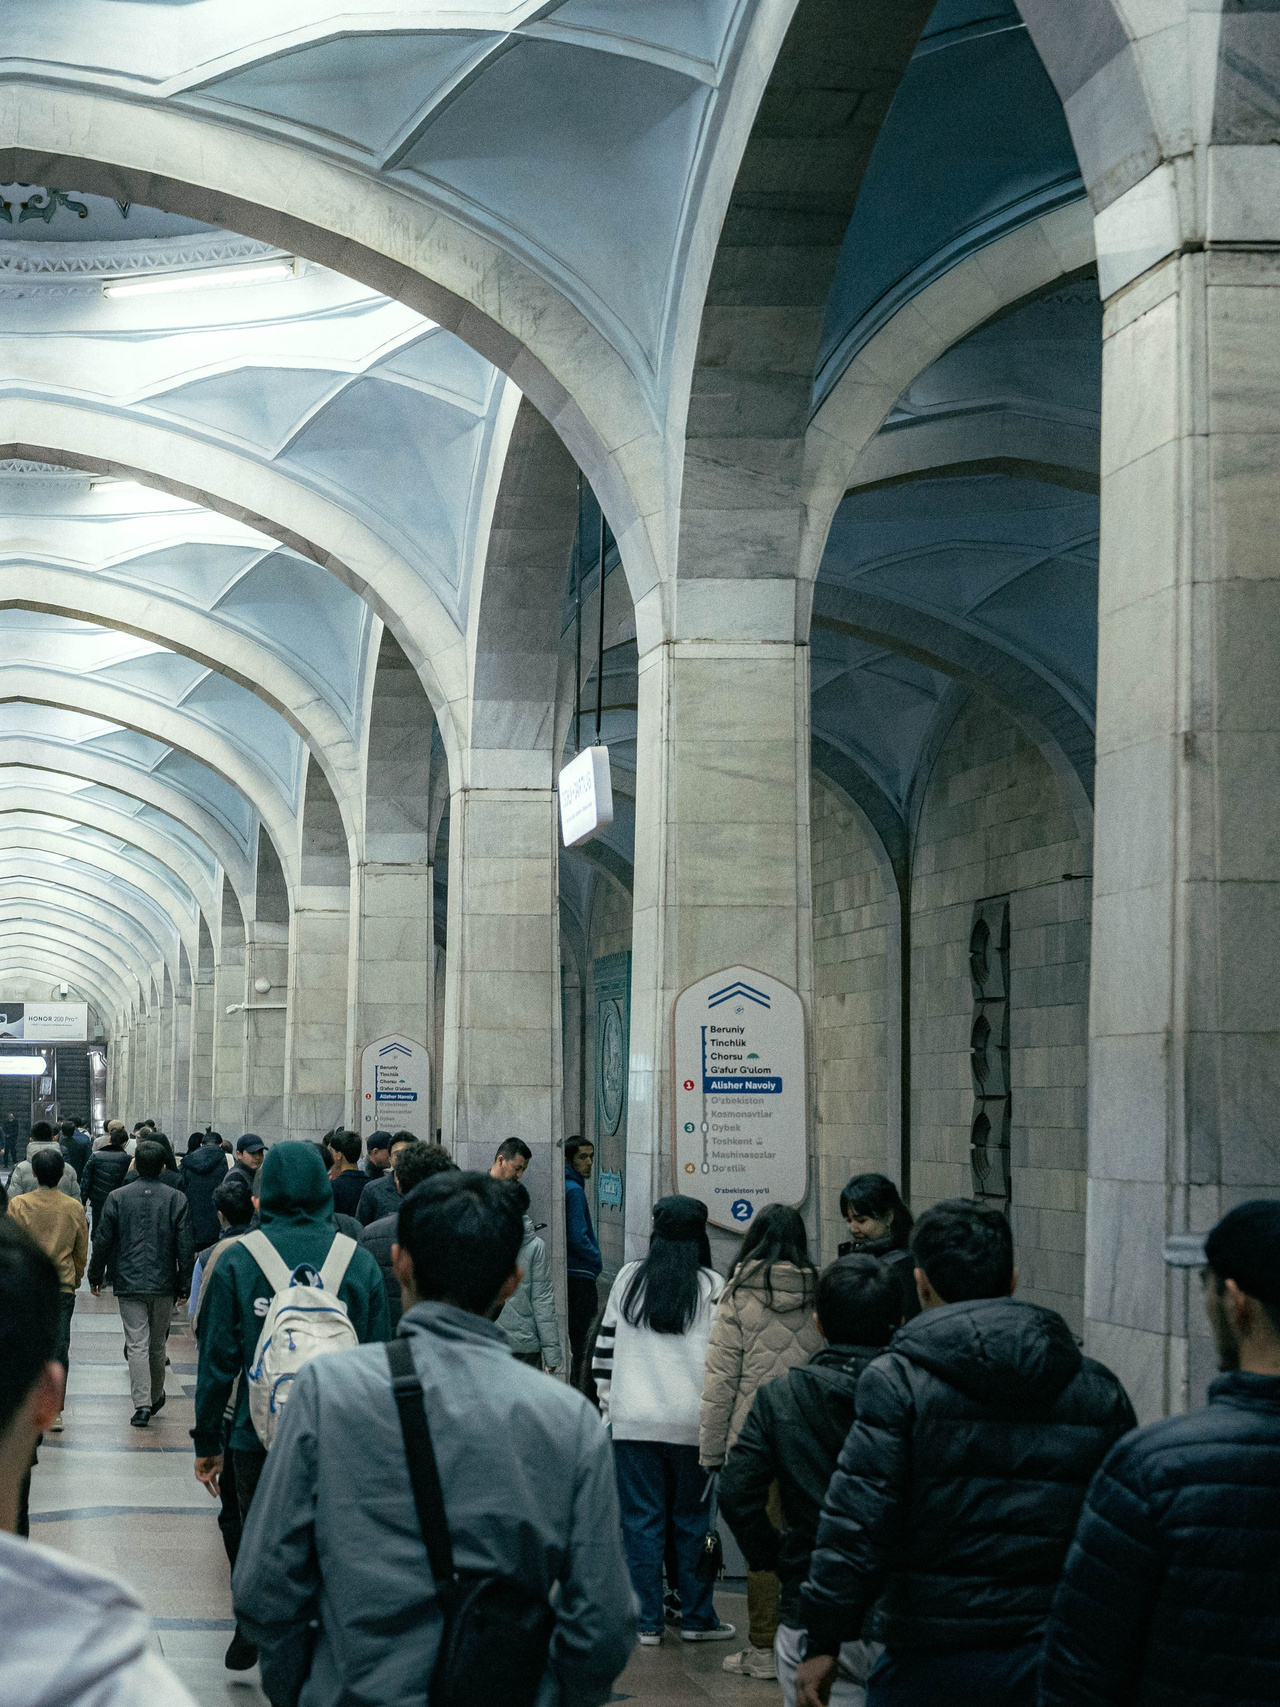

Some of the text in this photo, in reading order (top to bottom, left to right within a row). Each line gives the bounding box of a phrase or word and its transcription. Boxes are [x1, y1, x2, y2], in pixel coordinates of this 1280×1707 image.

[710, 1026, 745, 1034] Beruniy
[710, 1039, 746, 1047] Tinchlik
[711, 1081, 776, 1091] Alisher Navoiy
[711, 1110, 773, 1118] Kosmonavtlar
[711, 1124, 741, 1132] Oybek
[712, 1137, 752, 1145] Toshkent
[712, 1151, 776, 1159] Mashinasozlar
[736, 1203, 748, 1217] 2
